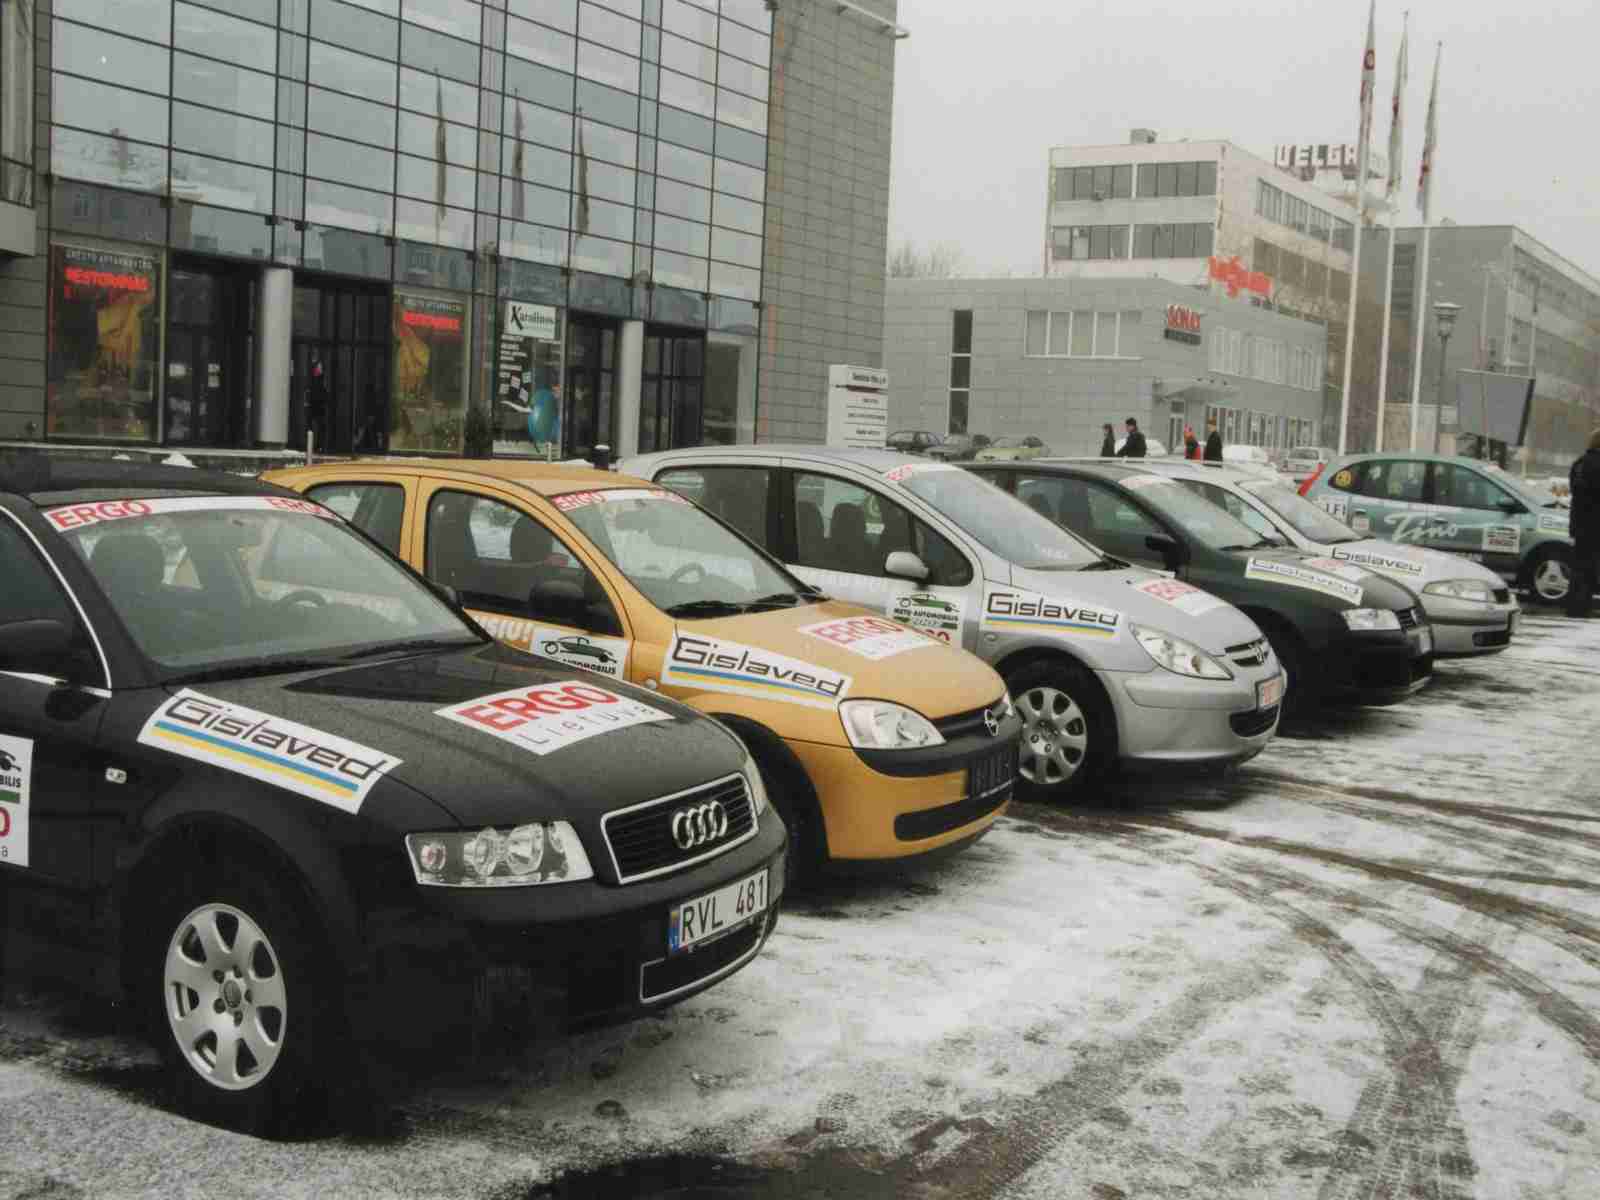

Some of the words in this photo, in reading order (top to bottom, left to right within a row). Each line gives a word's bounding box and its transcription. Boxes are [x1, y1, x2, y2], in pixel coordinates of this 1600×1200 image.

[53, 498, 151, 529] ERGO
[1384, 511, 1458, 544] Tino
[987, 592, 1119, 626] Gislaved
[672, 636, 845, 697] Gislaved
[456, 686, 620, 732] ERGO
[164, 696, 387, 780] Gislaved
[683, 896, 724, 942] RVL
[736, 876, 764, 915] 481
